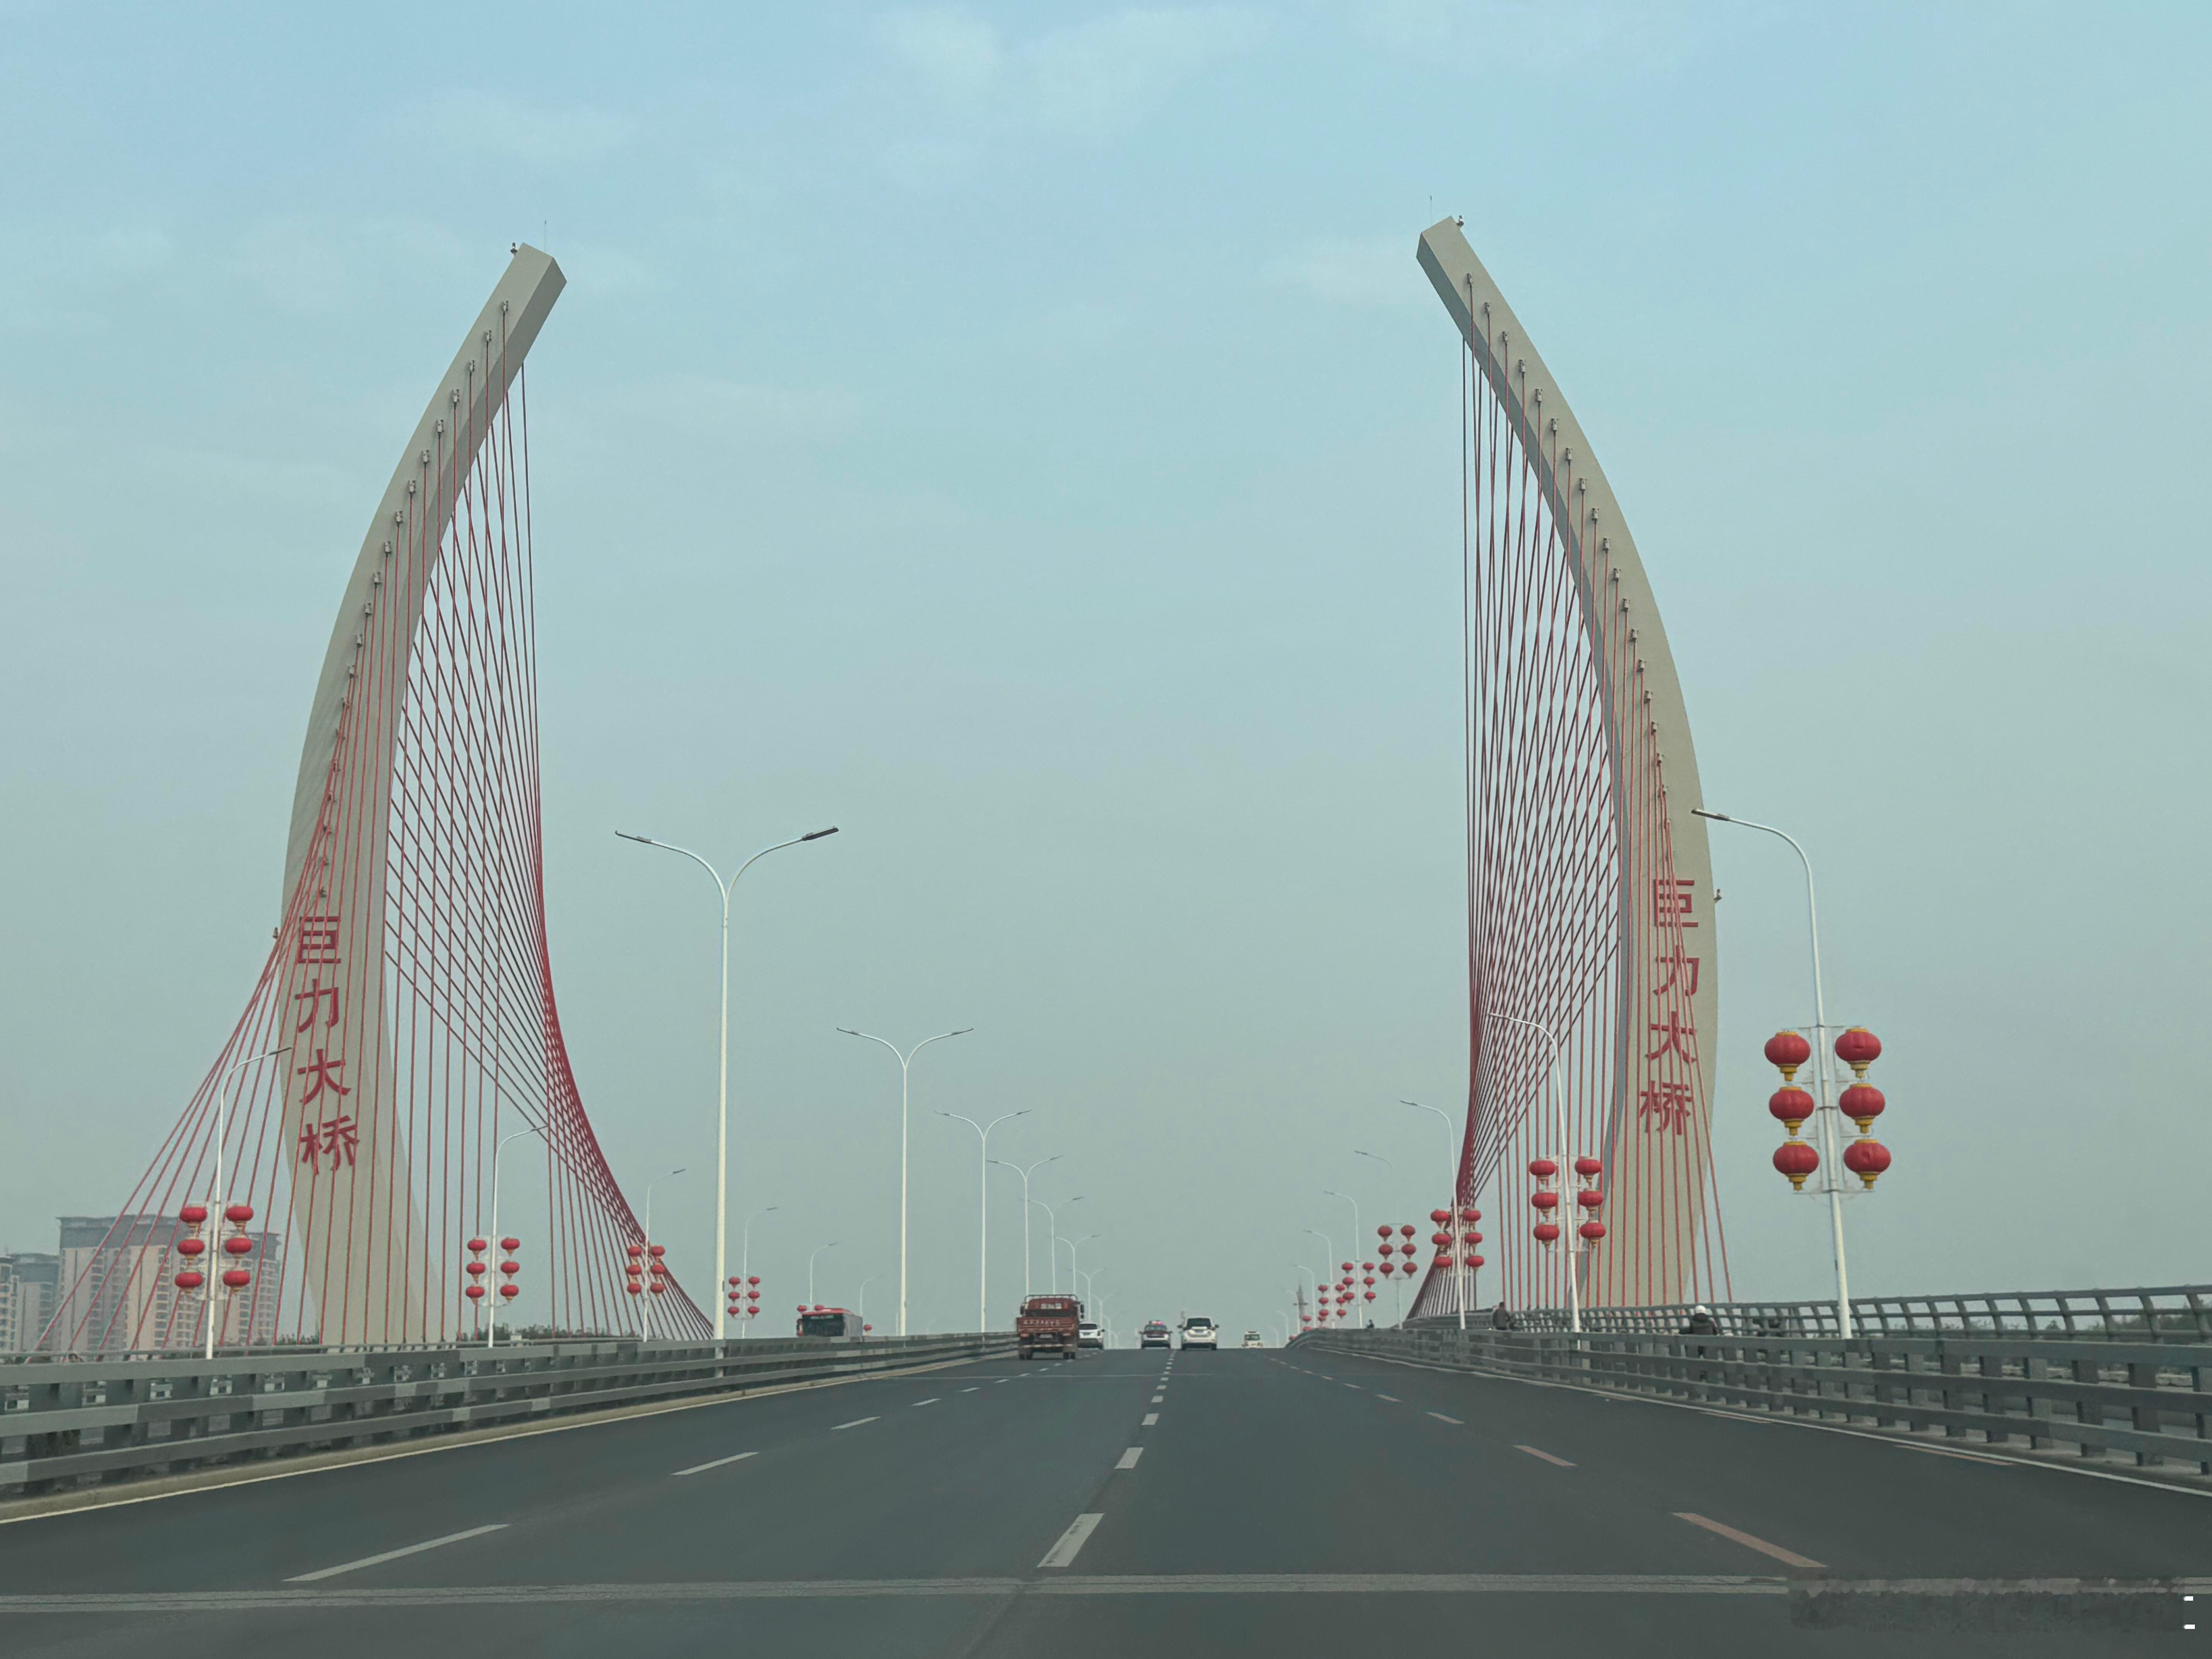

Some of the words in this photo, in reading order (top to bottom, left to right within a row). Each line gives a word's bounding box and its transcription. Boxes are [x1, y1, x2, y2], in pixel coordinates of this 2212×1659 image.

[295, 915, 359, 1175] 巨力大桥
[1640, 879, 1700, 1135] 巨力大桥
